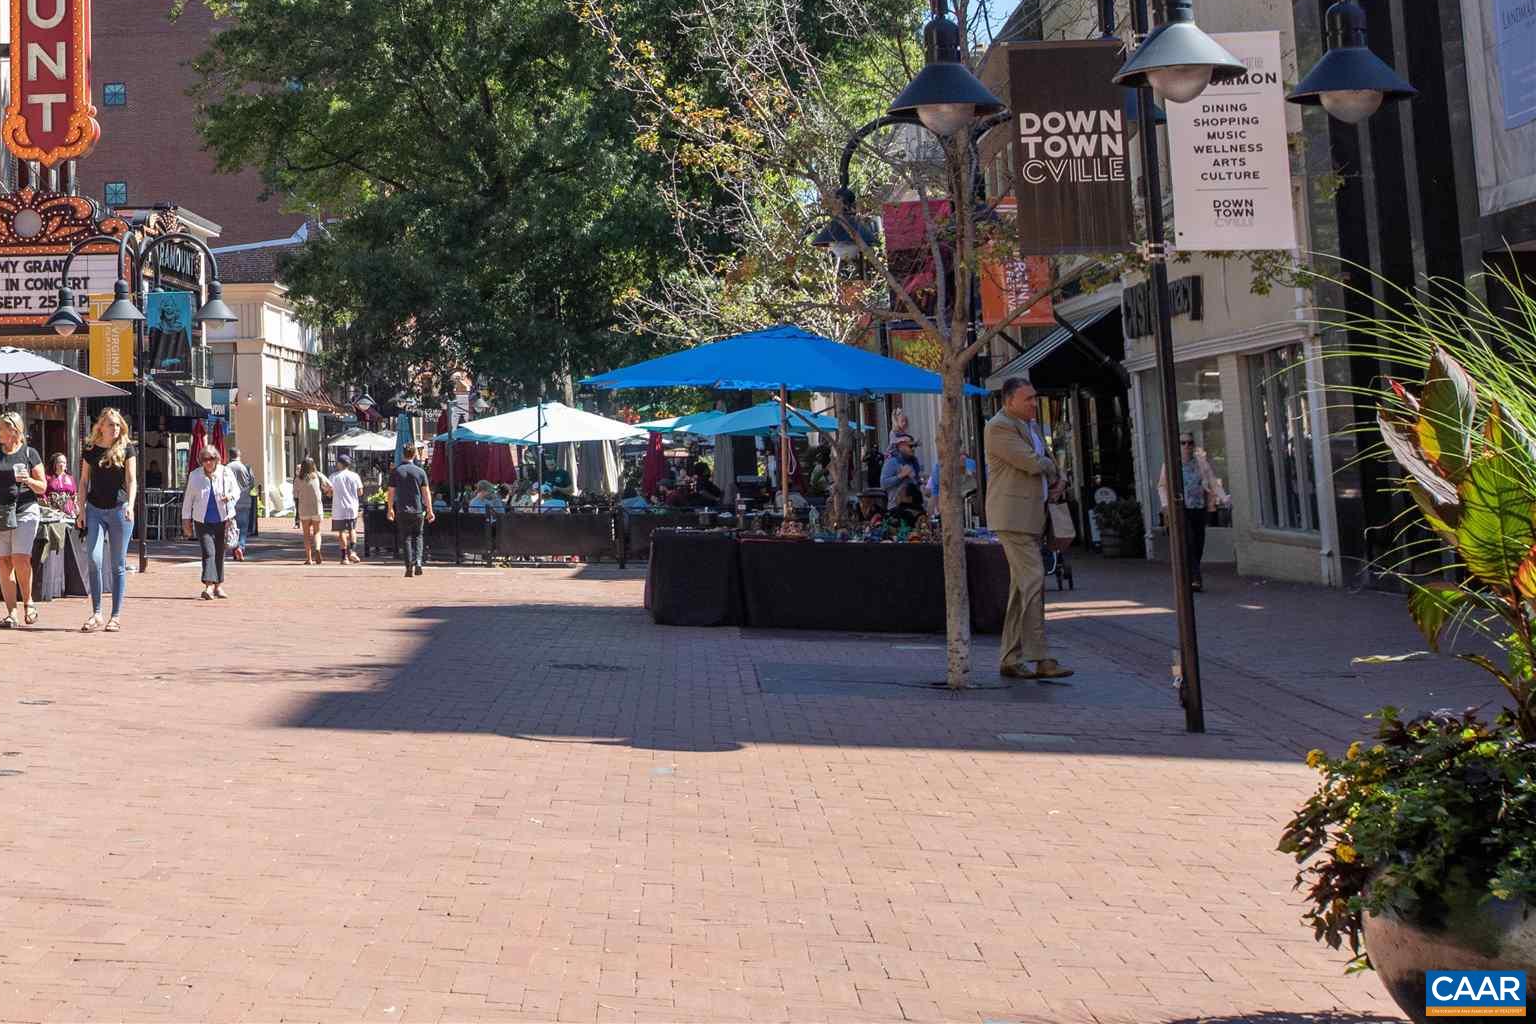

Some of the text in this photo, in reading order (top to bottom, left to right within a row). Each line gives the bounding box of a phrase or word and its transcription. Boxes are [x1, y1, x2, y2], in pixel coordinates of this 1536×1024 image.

[1202, 103, 1248, 113] DINING
[1019, 109, 1123, 135] DOWN
[1193, 116, 1260, 127] SHOPPING
[1207, 130, 1247, 140] MUSIC
[1020, 133, 1124, 159] TOWN
[1193, 143, 1264, 154] WELLNESS
[1212, 157, 1246, 167] ARTS
[1022, 157, 1125, 184] CVILLE
[1200, 170, 1261, 181] CULTURE
[1213, 199, 1254, 209] DOWN
[1213, 208, 1255, 218] TOWN
[23, 260, 65, 274] GRAN
[5, 278, 20, 292] IN
[24, 276, 90, 291] CONCERT
[111, 326, 121, 376] VIRGINIA
